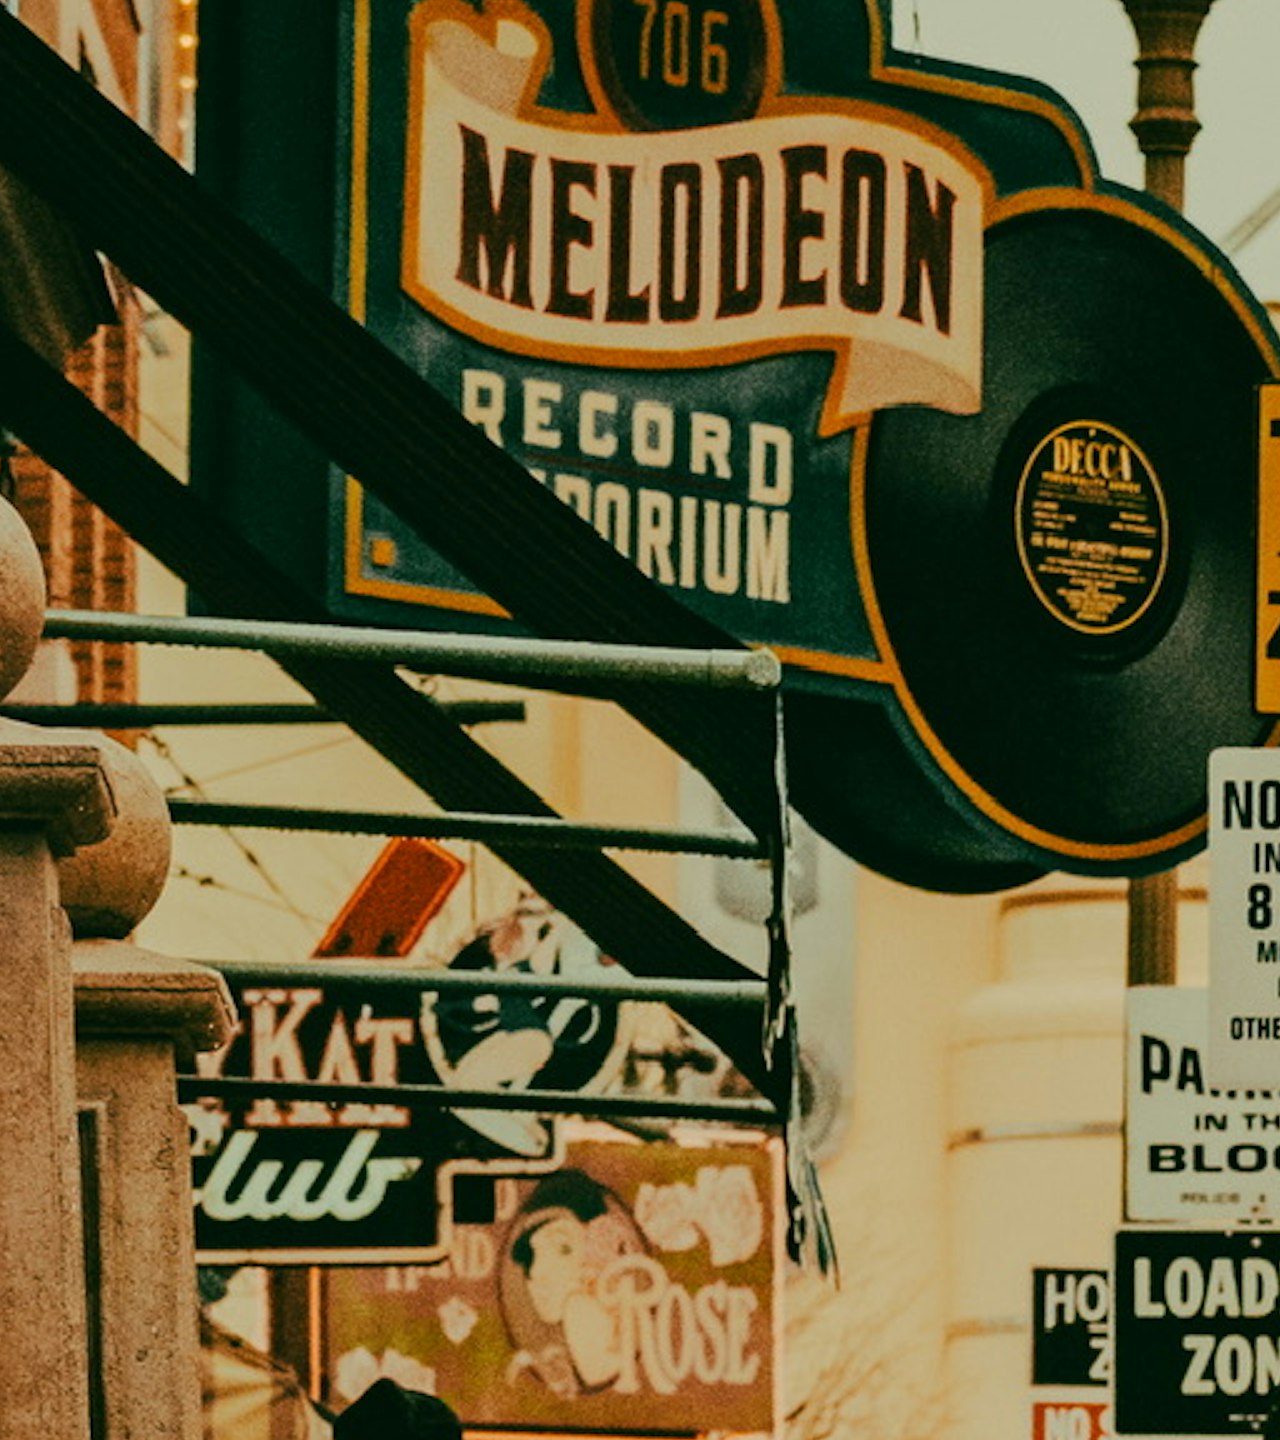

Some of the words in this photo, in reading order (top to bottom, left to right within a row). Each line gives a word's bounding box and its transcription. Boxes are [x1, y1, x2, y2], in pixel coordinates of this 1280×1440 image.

[455, 121, 958, 340] MELODEON
[462, 368, 794, 507] RECORD
[1052, 435, 1133, 483] DECCA
[526, 468, 792, 605] ORIUM
[1247, 883, 1273, 930] 8
[241, 987, 414, 1128] KAT
[1194, 1113, 1228, 1131] IN
[185, 1128, 422, 1222] lub
[1133, 1256, 1280, 1318] LOAD
